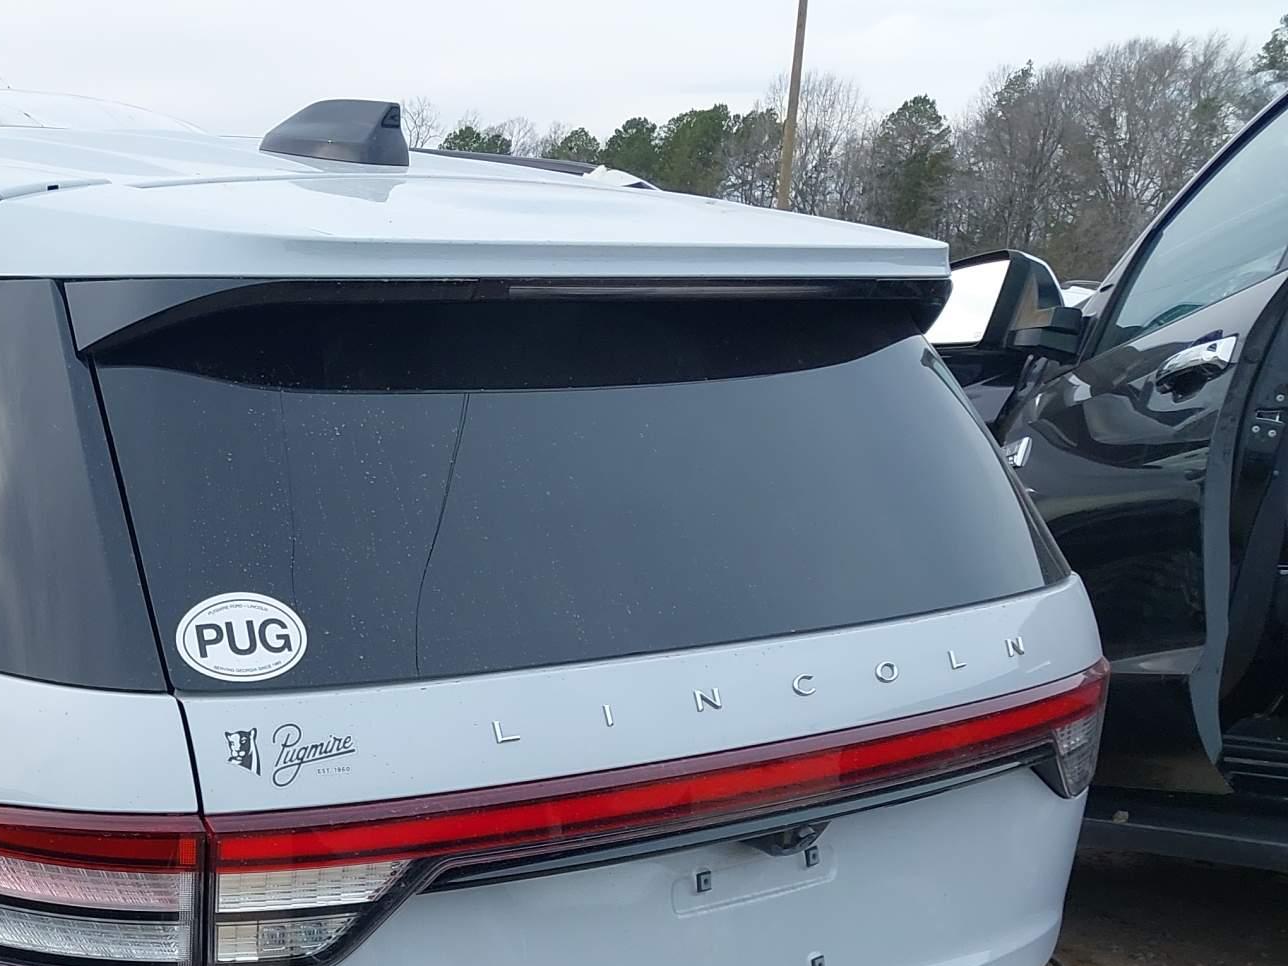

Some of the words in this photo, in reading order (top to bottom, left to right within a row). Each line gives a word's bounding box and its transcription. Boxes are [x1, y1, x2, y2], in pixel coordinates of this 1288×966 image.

[195, 618, 293, 658] PUG
[491, 635, 1025, 745] LINCOLN
[272, 723, 356, 787] Pugmire
